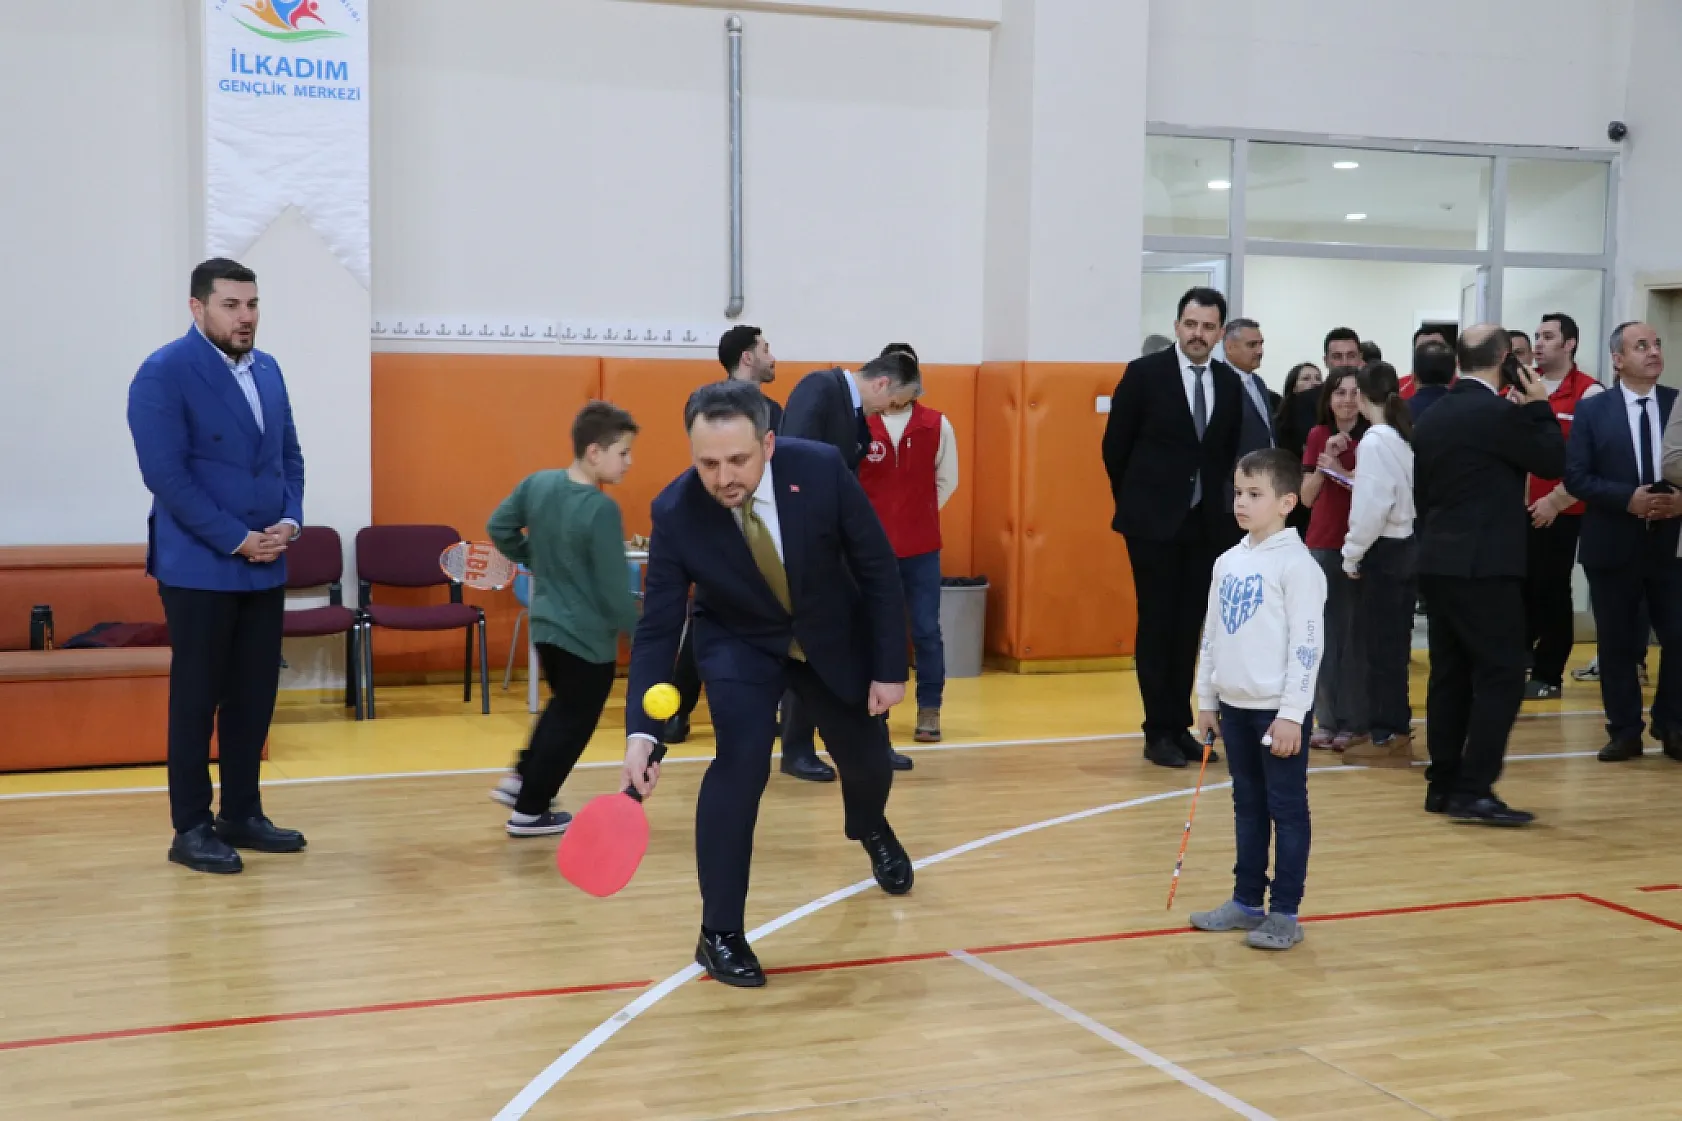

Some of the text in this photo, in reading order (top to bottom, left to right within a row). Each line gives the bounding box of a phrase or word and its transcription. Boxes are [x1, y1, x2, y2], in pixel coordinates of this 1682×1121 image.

[231, 48, 348, 80] İLKADIM
[218, 79, 361, 101] GENÇLİK MERKEZİ
